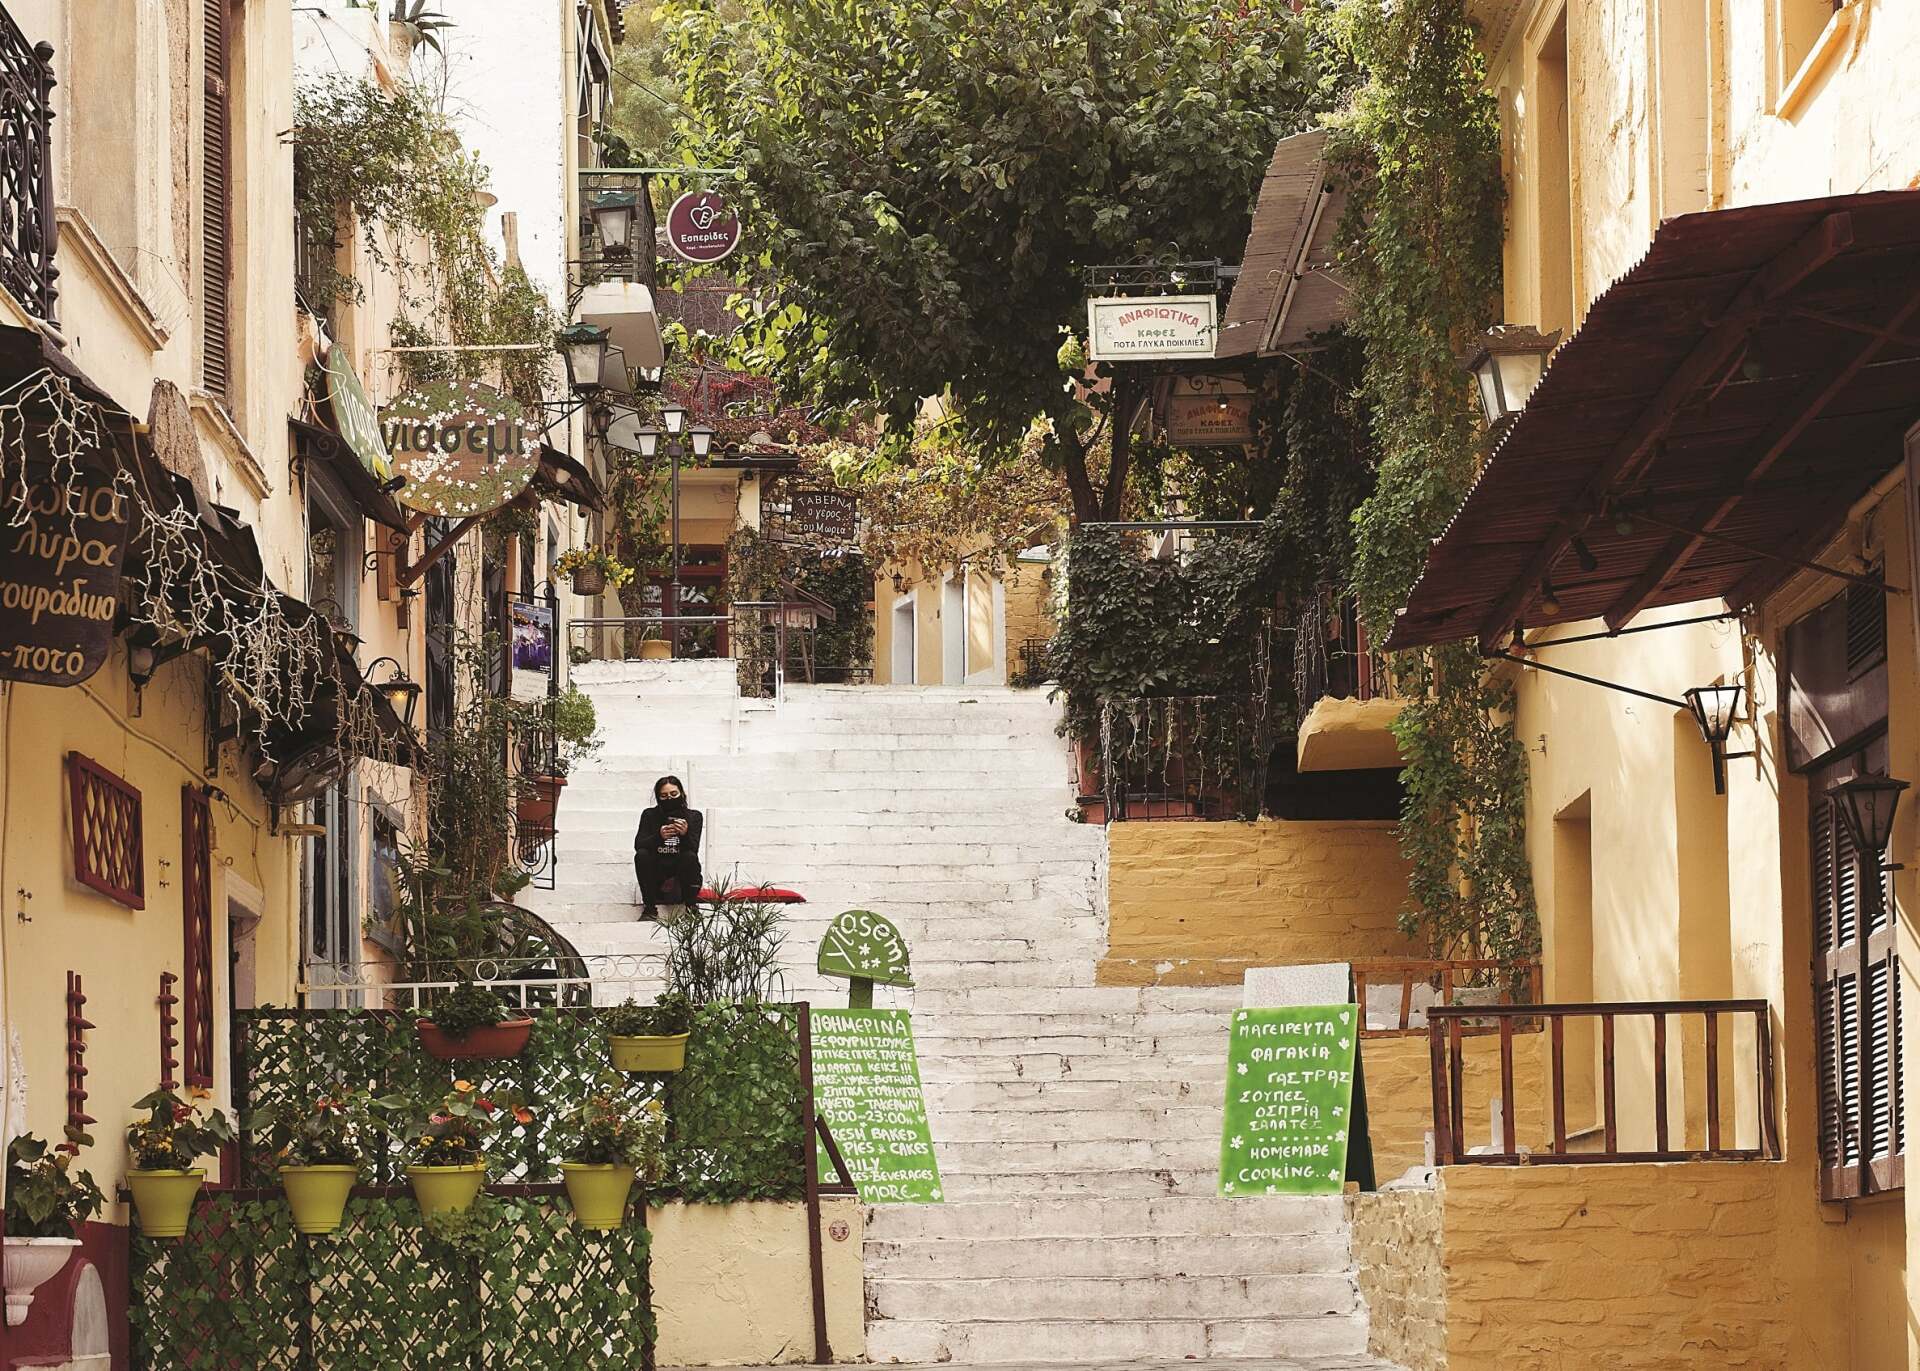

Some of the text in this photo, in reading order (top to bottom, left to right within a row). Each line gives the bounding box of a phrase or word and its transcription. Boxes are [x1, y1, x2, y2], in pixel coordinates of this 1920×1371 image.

[681, 231, 729, 243] Εσπερίδες
[1118, 307, 1200, 328] ΑΝΑΦΙΩΤΙΚΑ
[1137, 328, 1176, 338] ΚΑΦΕΣ
[1113, 338, 1205, 349] ΠΟΤΑ ΓΛΥΚΑ ΠΟΙΚΙΛΙΕΣ
[1187, 404, 1248, 420] ΑΝΑΦΙΤΙΚΑ
[797, 495, 852, 511] ΤΑΒΕΡΝΑ
[9, 516, 117, 576] λύρα
[0, 578, 116, 625] ουράδικο
[657, 846, 680, 854] adid
[811, 1012, 908, 1037] ΑΘΗΜΕΡΙΝΑ
[1240, 1021, 1334, 1038] ΜΑΓΕΙΡΕΥΤΑ
[811, 1049, 850, 1060] ΠΙΤΙΚΕΣ
[1268, 1069, 1350, 1088] ΓΑΣΤΡΑΣ
[1249, 1118, 1322, 1131] ΣΑΛΑΤΕΣ
[830, 1127, 917, 1141] RESH BAKED
[843, 1141, 874, 1156] PIES
[889, 1142, 929, 1156] CAKES
[1250, 1144, 1329, 1160] HOMEMADE
[845, 1157, 883, 1172] AILY.
